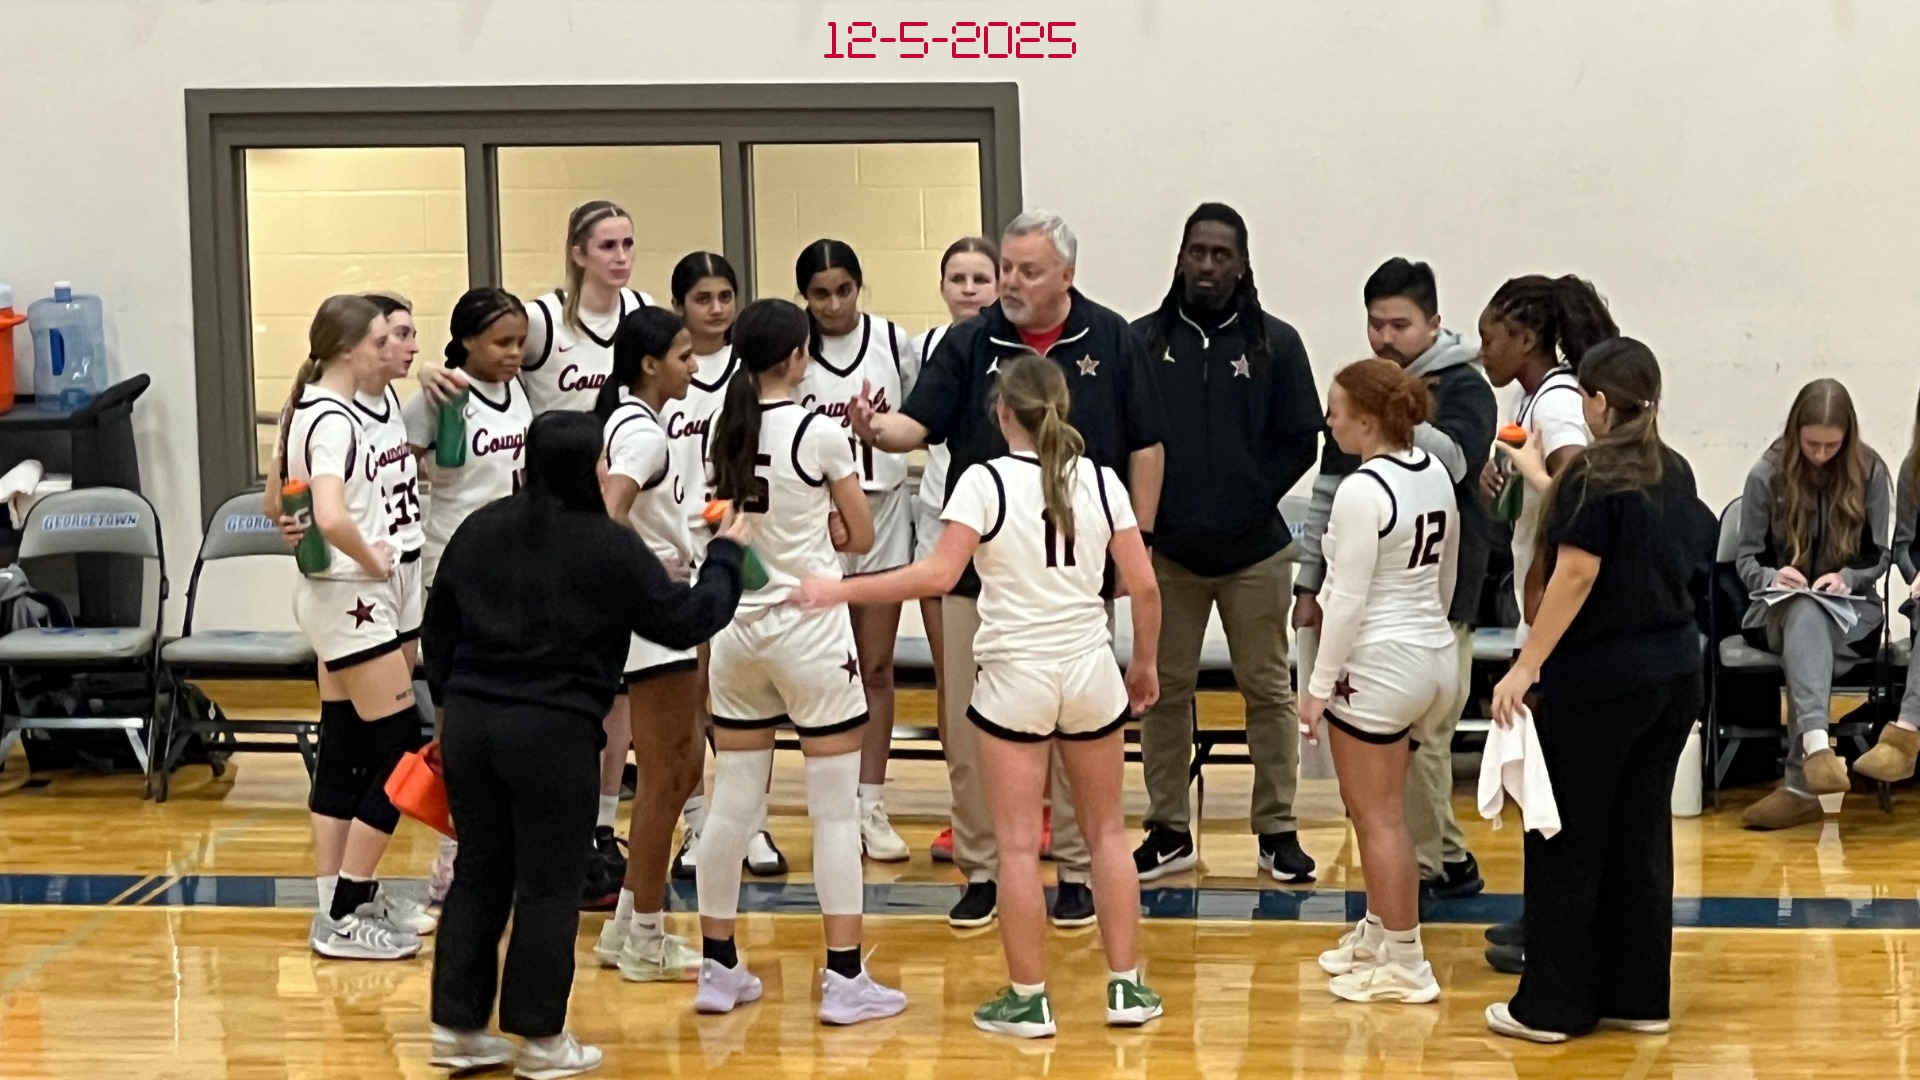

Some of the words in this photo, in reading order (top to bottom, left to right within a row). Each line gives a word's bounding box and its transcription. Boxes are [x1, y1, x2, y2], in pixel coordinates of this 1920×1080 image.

[559, 364, 606, 391] Cow
[42, 513, 139, 531] GEORGETOWN
[1041, 507, 1076, 568] 11
[1407, 511, 1446, 568] 12
